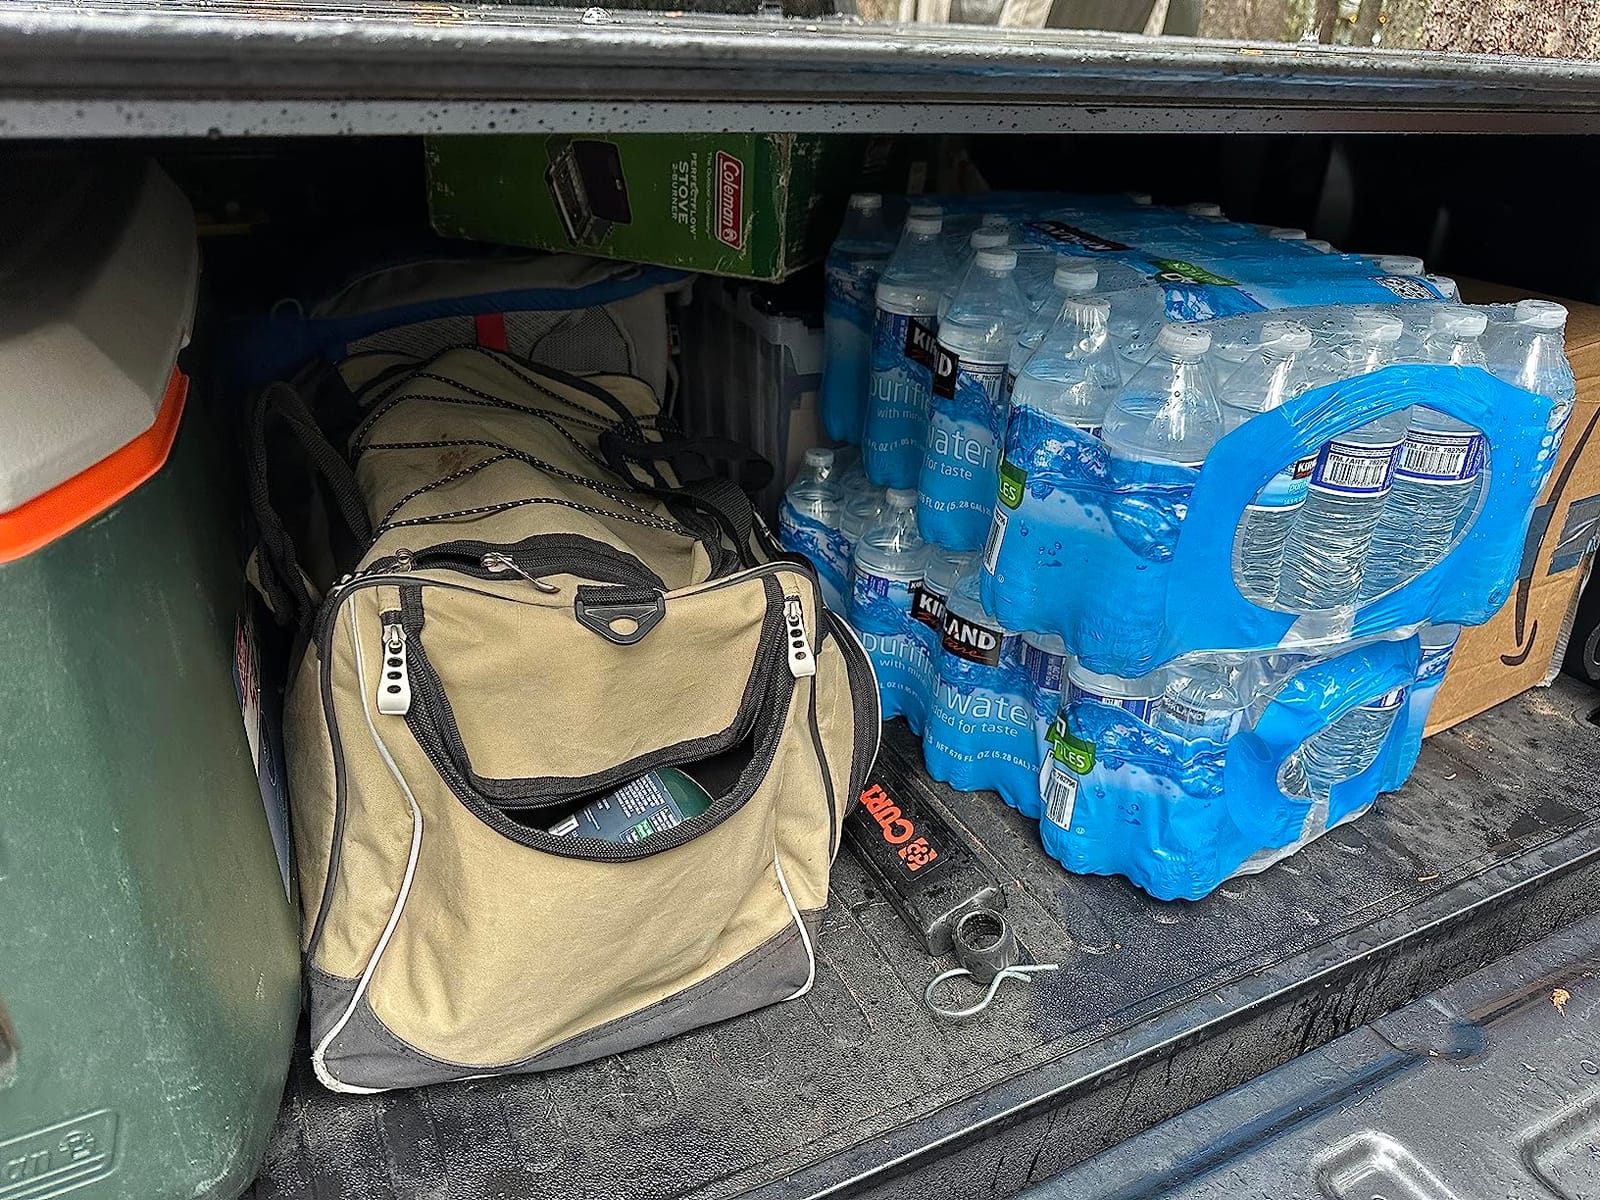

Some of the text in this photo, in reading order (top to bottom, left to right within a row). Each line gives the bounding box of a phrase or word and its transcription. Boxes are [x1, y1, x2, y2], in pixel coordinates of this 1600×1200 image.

[678, 161, 689, 224] STOVE
[723, 161, 740, 227] Coleman
[940, 462, 973, 481] taste
[934, 500, 945, 512] OZ
[946, 500, 970, 513] (5.28
[880, 659, 905, 671] with
[886, 681, 897, 689] OZ
[958, 719, 976, 735] for
[980, 722, 1018, 738] taste
[935, 741, 949, 755] NET
[976, 750, 990, 760] OZ
[991, 751, 1012, 763] (5.28
[1012, 757, 1031, 771] GAL)
[860, 783, 914, 844] CURT
